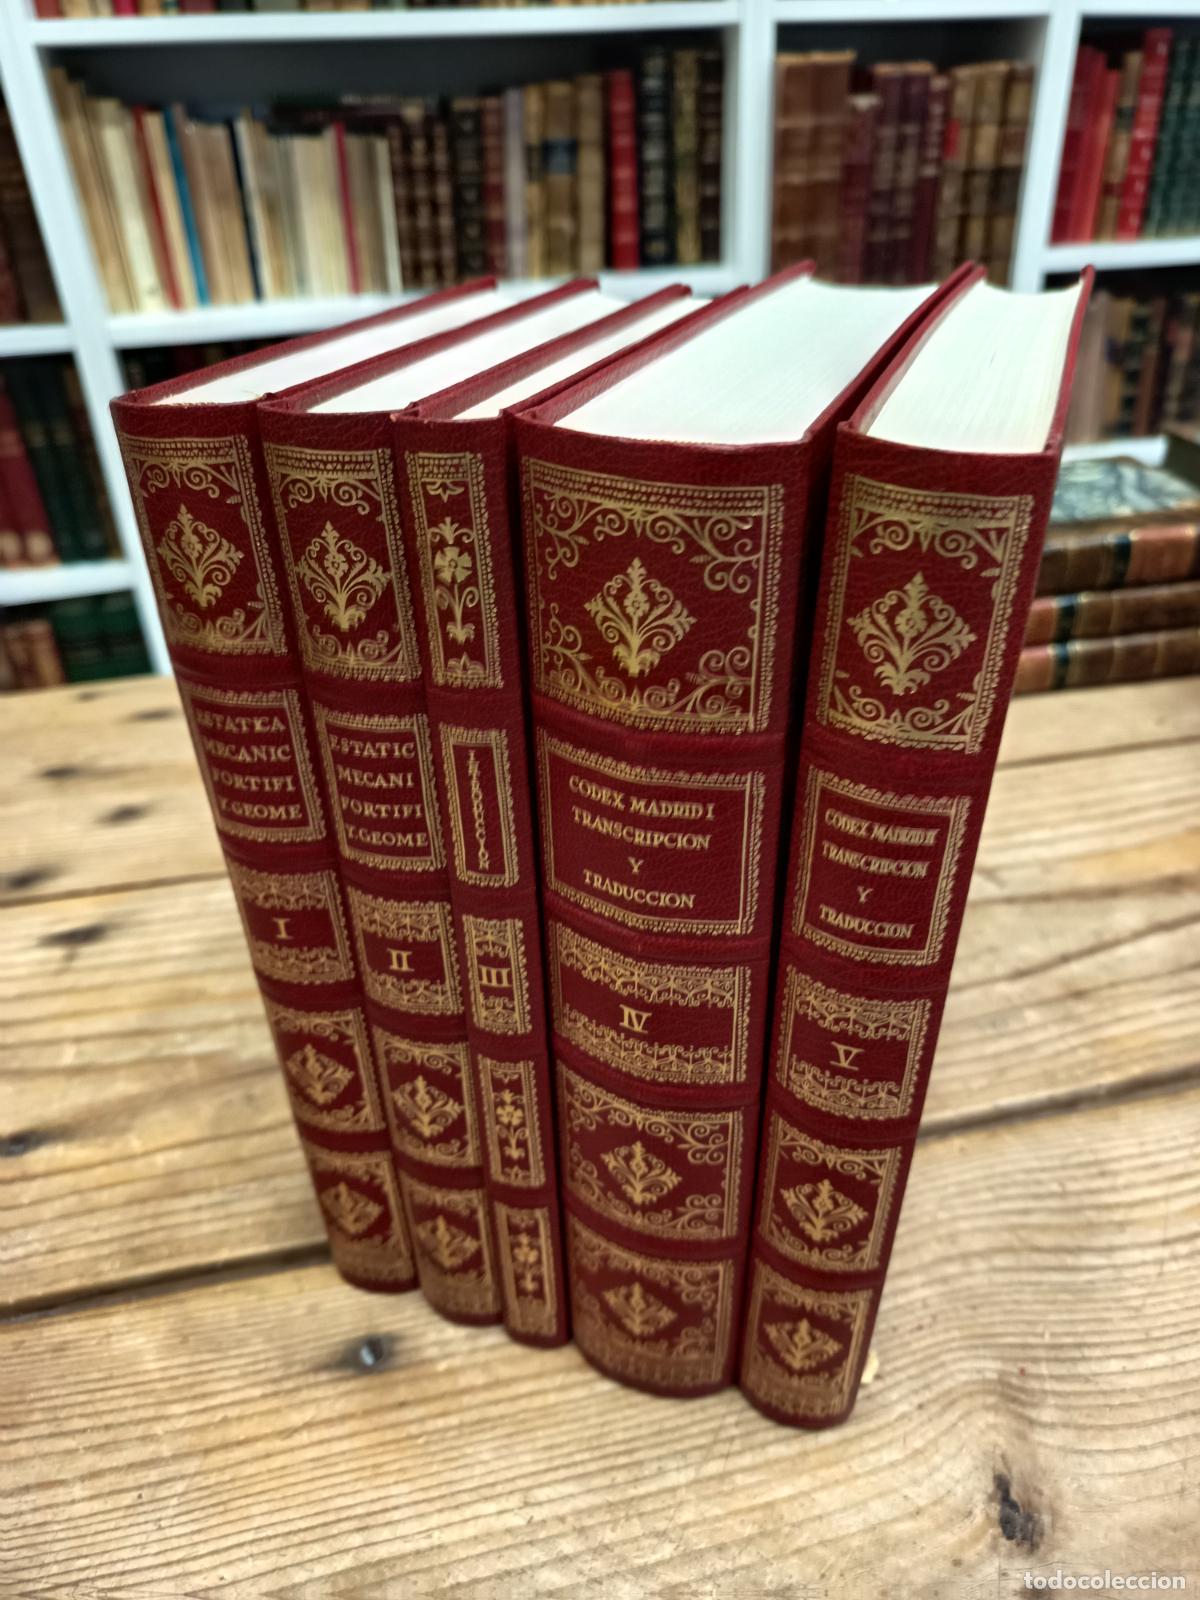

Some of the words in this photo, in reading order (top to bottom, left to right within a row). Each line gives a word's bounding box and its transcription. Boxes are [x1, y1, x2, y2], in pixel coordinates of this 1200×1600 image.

[337, 764, 415, 789] MECANI
[340, 795, 423, 820] FORTIFI
[569, 775, 626, 811] CODEX
[629, 796, 703, 820] MADRID
[706, 803, 716, 821] I
[572, 805, 712, 850] TRANSCRIPCION
[824, 808, 873, 838] CODEX
[628, 856, 644, 876] Y
[821, 840, 931, 879] TRANSCRIPCION
[583, 868, 696, 909] TRADUCCION
[856, 885, 875, 904] Y
[272, 917, 294, 941] I
[819, 903, 916, 940] TRADUCCION
[387, 948, 415, 973] II
[478, 964, 512, 988] III
[619, 1003, 653, 1035] IV
[830, 1041, 865, 1072] V
